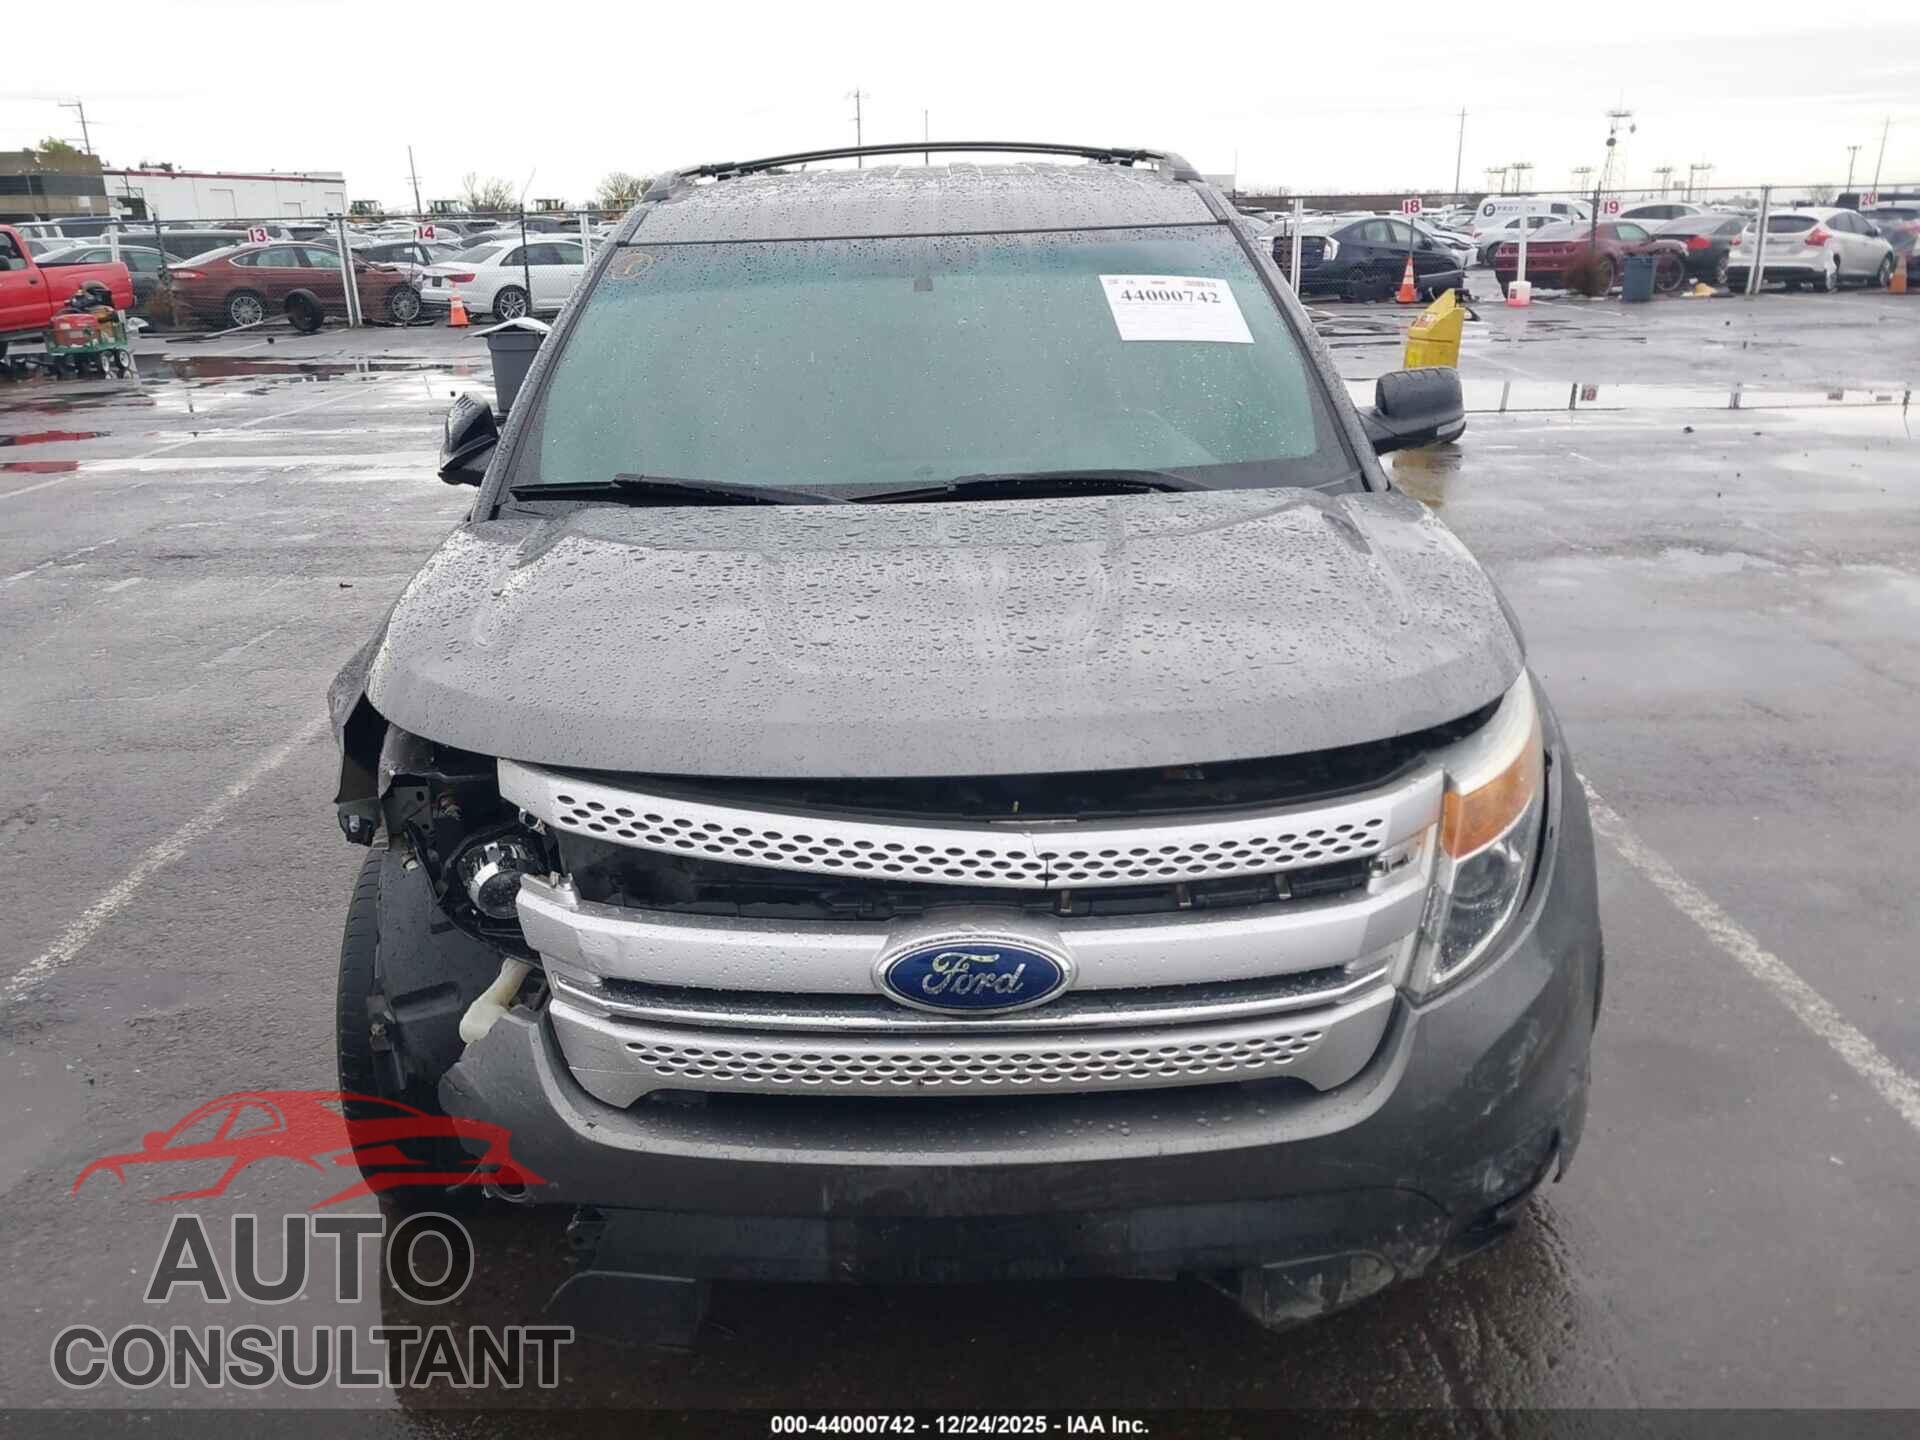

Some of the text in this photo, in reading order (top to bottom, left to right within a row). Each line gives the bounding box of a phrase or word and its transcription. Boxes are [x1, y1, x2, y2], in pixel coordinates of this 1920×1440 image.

[1404, 200, 1420, 214] 18
[1603, 200, 1619, 214] 19
[249, 228, 267, 242] 13
[418, 226, 435, 240] 14
[1120, 289, 1222, 304] 44000742
[922, 952, 1026, 995] Ford
